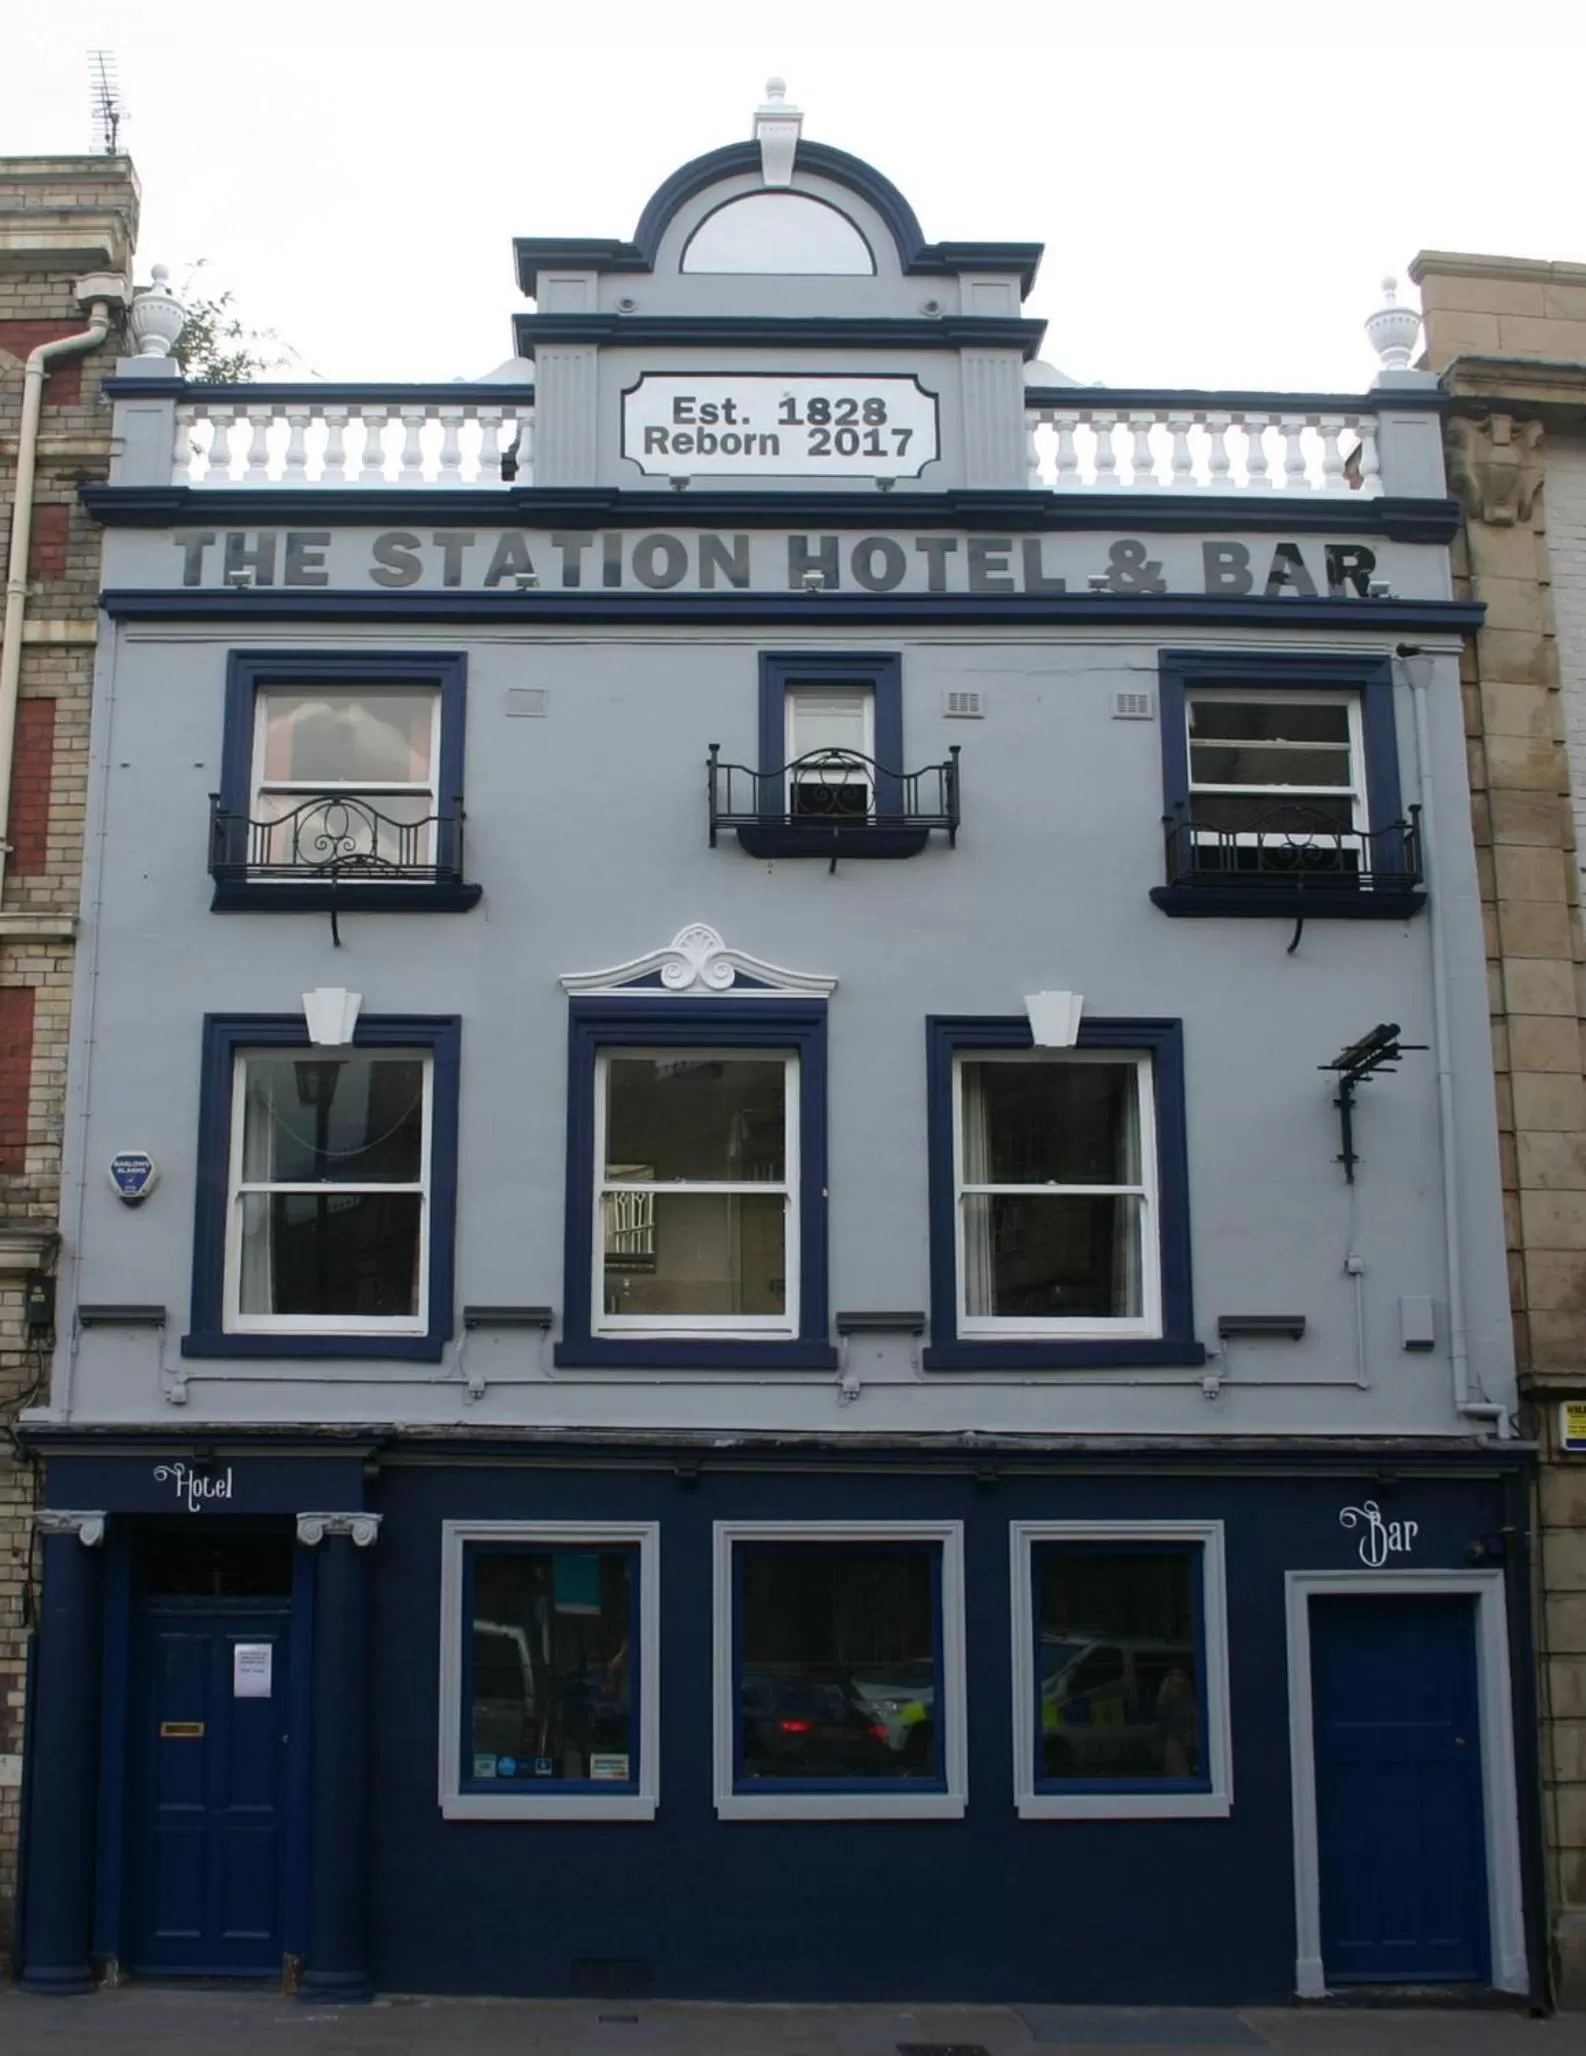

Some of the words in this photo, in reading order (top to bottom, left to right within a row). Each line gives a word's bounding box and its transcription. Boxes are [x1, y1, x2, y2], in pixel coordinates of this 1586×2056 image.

[672, 396, 750, 425] Est.
[777, 396, 888, 426] 1828
[643, 426, 780, 455] Reborn
[807, 428, 913, 457] 2017
[174, 531, 331, 587] THE
[368, 532, 751, 589] STATION
[786, 535, 1066, 593] HOTEL
[1104, 539, 1168, 593] &
[1201, 541, 1378, 599] BAR
[153, 1462, 233, 1512] Hotel
[1339, 1500, 1418, 1567] Bar
